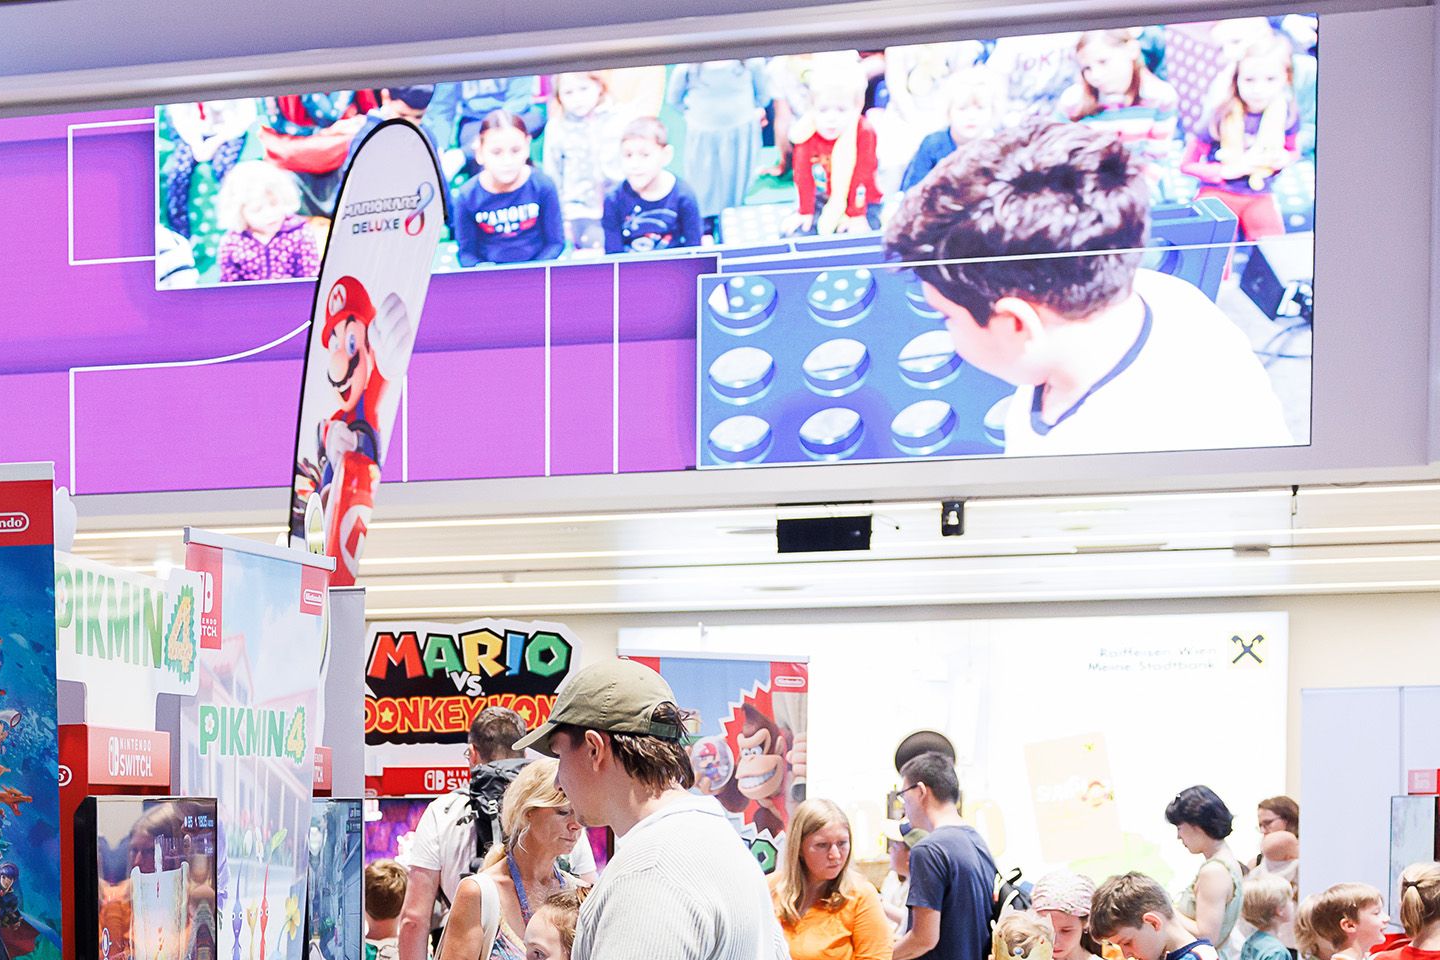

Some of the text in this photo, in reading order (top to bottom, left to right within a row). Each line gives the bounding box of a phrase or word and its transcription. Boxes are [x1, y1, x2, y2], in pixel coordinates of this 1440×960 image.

[352, 218, 400, 235] DELUXE
[56, 562, 196, 680] PIKMIN 4
[366, 629, 571, 680] MARIO
[450, 670, 486, 697] VS.
[365, 696, 487, 734] DONKEY
[119, 737, 152, 750] NINTENDO
[199, 705, 306, 762] PIKMIN 4
[119, 753, 153, 777] SWITCH
